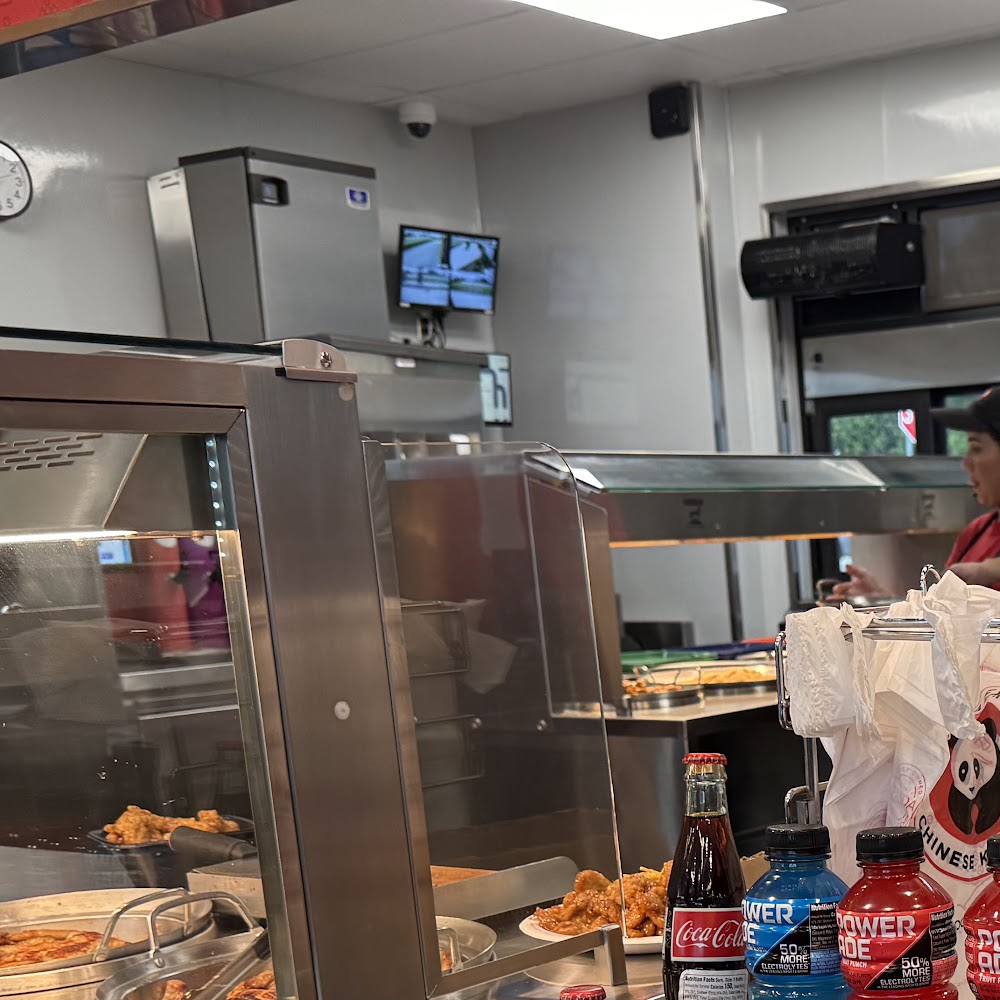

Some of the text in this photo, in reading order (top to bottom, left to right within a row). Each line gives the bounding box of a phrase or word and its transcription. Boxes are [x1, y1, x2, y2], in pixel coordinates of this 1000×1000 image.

[918, 815, 974, 869] CHINESE
[837, 915, 916, 938] POWER
[780, 955, 809, 964] MORE
[901, 957, 930, 968] 50%
[902, 967, 931, 978] MORE
